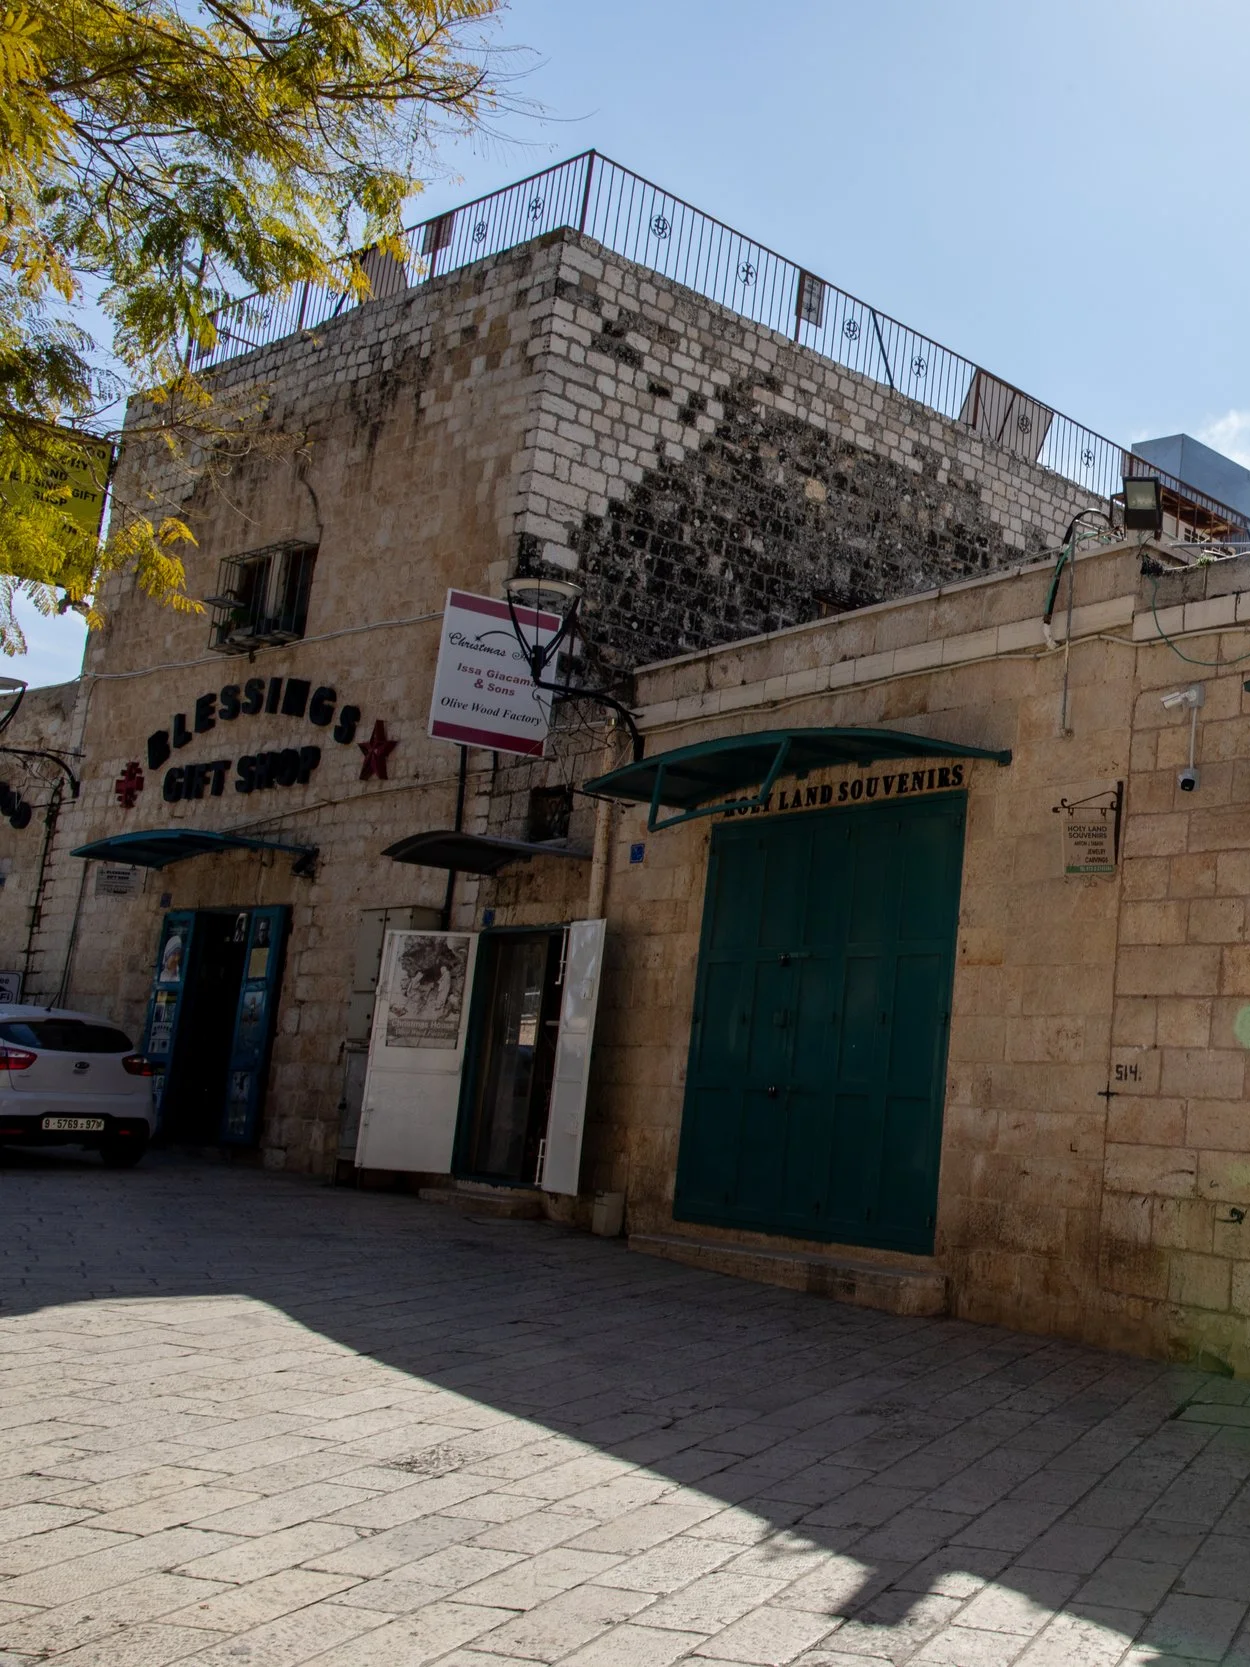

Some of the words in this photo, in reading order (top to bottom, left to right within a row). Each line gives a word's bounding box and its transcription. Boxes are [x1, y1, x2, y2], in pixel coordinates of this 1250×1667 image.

[72, 488, 98, 502] GIFT
[448, 632, 507, 657] Christmas
[456, 662, 482, 676] Issa
[486, 669, 538, 688] Giacama
[474, 678, 485, 689] &
[487, 682, 516, 697] Sons
[147, 677, 361, 770] BLESSINGS
[440, 696, 469, 711] Olive
[471, 702, 500, 717] Wood
[502, 709, 542, 727] Factory
[163, 760, 232, 802] GIFT
[235, 746, 321, 793] SHOP
[779, 784, 833, 811] LAND
[838, 764, 964, 802] SOUVENIRS
